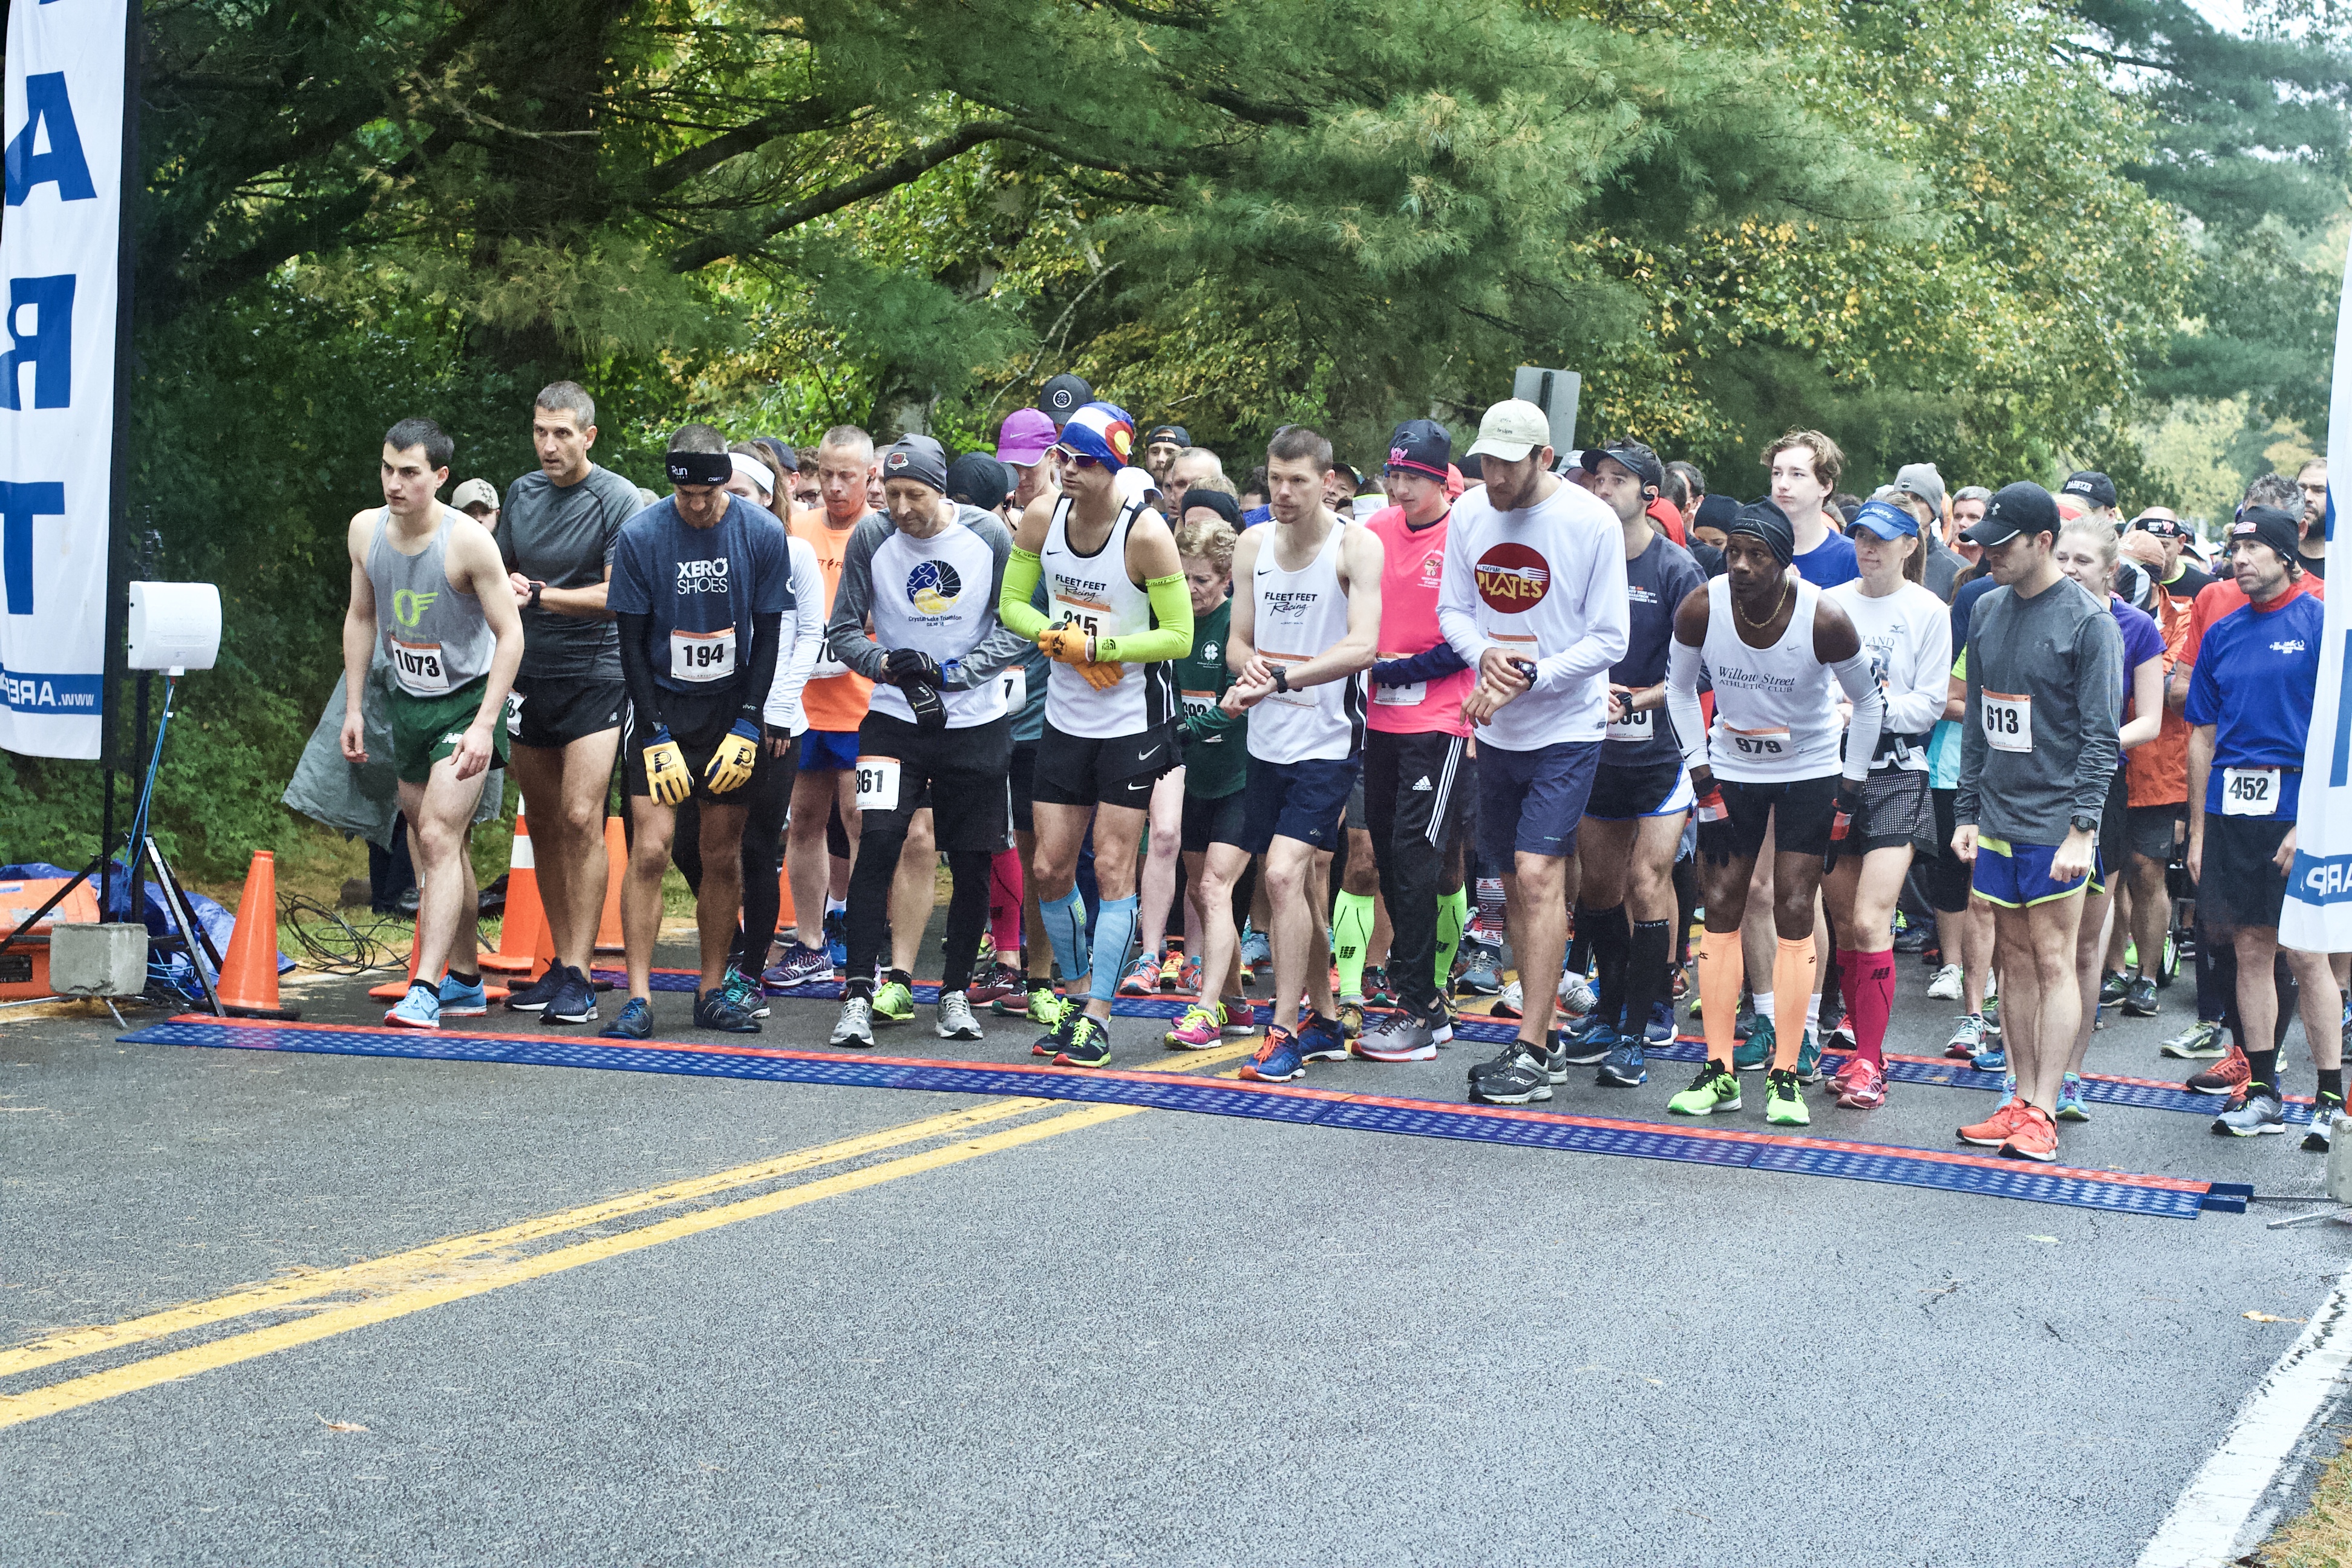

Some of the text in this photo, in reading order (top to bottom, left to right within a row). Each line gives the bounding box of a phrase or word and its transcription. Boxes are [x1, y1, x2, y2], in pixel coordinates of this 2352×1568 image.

[676, 557, 728, 579] XERO
[677, 577, 728, 595] SHOES
[1056, 573, 1106, 591] FLEET FEET
[1477, 571, 1543, 599] PLATES
[1059, 584, 1101, 603] Racing
[1265, 592, 1318, 602] FLEET FEET
[1267, 602, 1312, 618] Racing
[1063, 610, 1098, 640] 215
[395, 649, 440, 678] 1073
[683, 643, 724, 667] 194
[1719, 666, 1795, 687] Willow Street
[1719, 679, 1765, 690] ATHLETIC
[1987, 704, 2019, 734] 613
[1735, 737, 1782, 754] 979
[2228, 776, 2269, 801] 452
